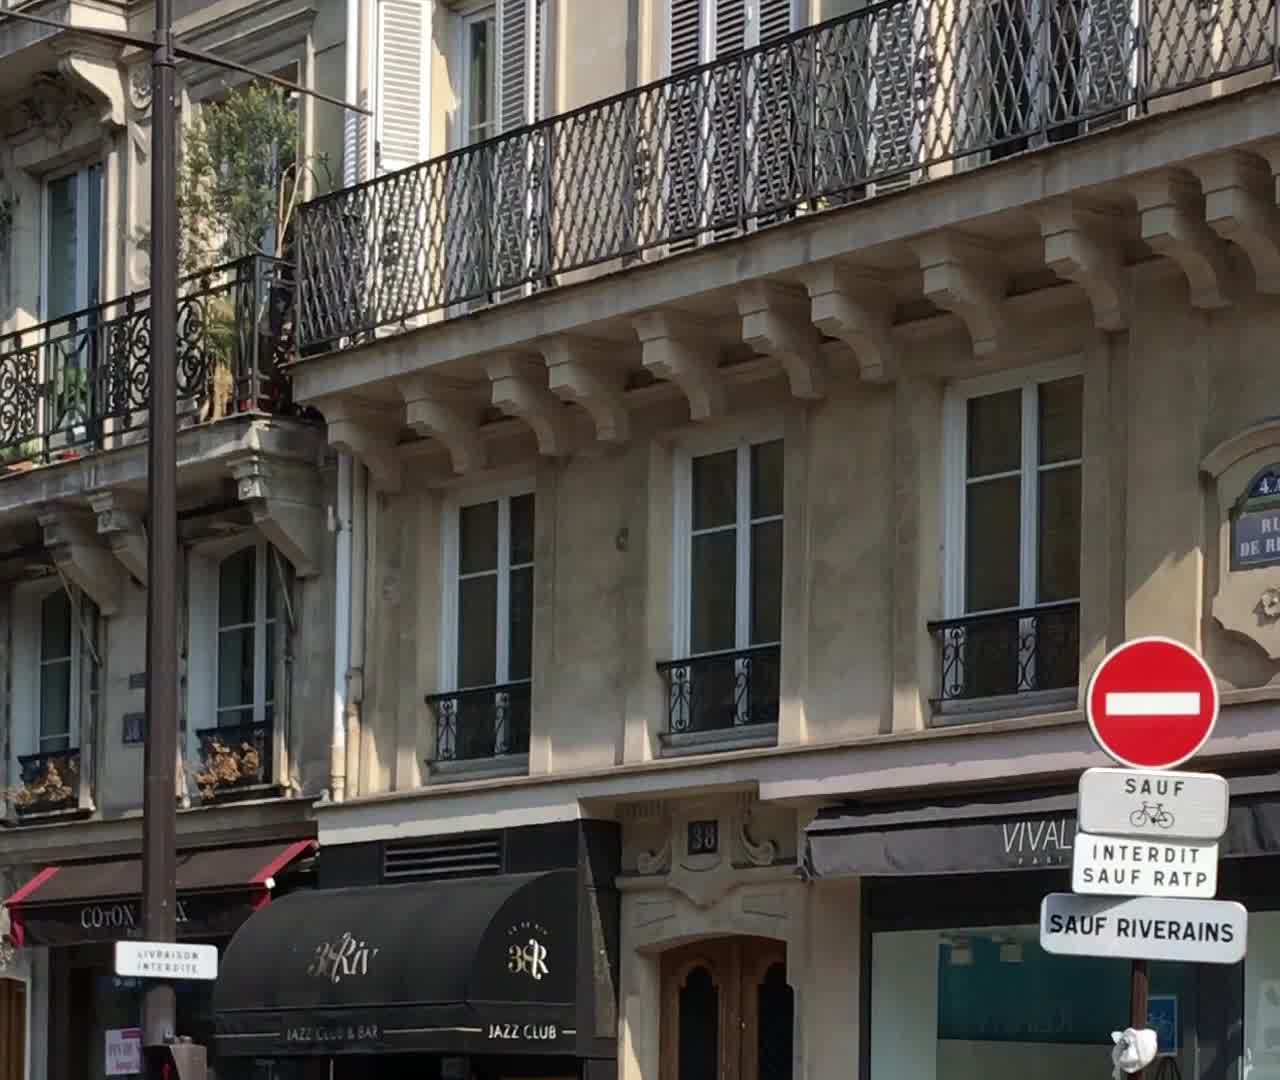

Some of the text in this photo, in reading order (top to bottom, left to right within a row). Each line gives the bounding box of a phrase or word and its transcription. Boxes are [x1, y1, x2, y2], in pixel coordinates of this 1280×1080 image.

[1239, 540, 1261, 557] DE
[1124, 778, 1185, 797] SAUF
[1003, 818, 1073, 853] VIVAL
[1092, 844, 1200, 864] INTERDIT
[1083, 867, 1208, 888] SAUF RATP
[1050, 914, 1234, 943] SAUF RIVERAINS
[137, 950, 200, 961] LIVRAISON
[137, 962, 199, 975] INTERDITE
[488, 1025, 557, 1039] JAZZ CLUB
